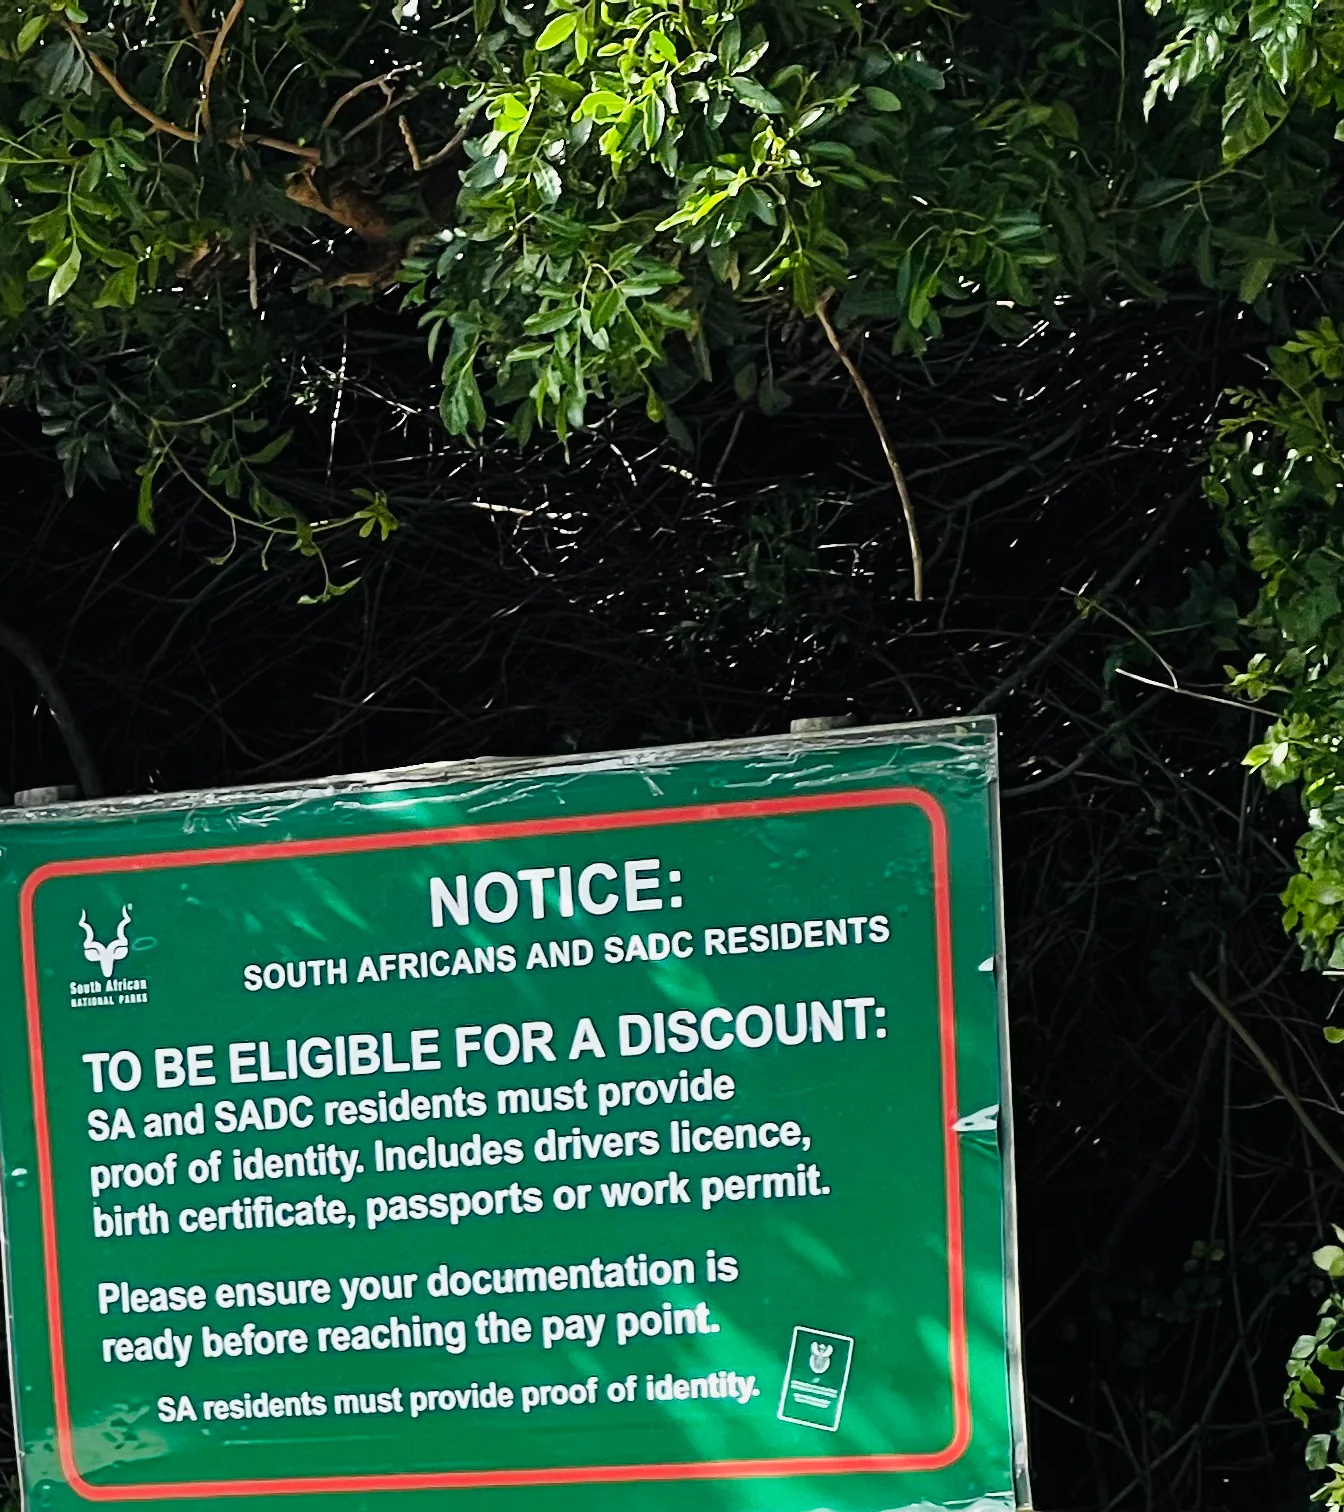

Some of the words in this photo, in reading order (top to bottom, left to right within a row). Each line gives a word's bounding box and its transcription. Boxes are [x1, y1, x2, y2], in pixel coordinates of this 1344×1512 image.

[430, 858, 682, 928] NOTICE:
[69, 981, 102, 995] South
[105, 978, 148, 992] African
[244, 958, 348, 991] SOUTH
[357, 944, 517, 983] AFRICANS
[526, 939, 594, 970] AND
[604, 930, 694, 964] SADC
[704, 915, 890, 956] RESIDENTS
[82, 1050, 142, 1093] TO
[154, 1044, 216, 1089] BE
[229, 1029, 441, 1084] ELIGIBLE
[455, 1021, 557, 1068] FOR
[568, 1017, 606, 1060] A
[618, 997, 887, 1056] DISCOUNT:
[87, 1108, 136, 1142] SA
[144, 1102, 205, 1138] and
[214, 1095, 314, 1133] SADC
[325, 1086, 487, 1126] residents
[497, 1078, 588, 1115] must
[598, 1068, 735, 1116] provide
[90, 1152, 178, 1198] proof
[188, 1149, 222, 1184] of
[233, 1143, 364, 1183] identity.
[374, 1133, 524, 1172] Includes
[534, 1127, 660, 1162] drivers
[670, 1120, 811, 1154] licence,
[93, 1202, 170, 1238] birth
[179, 1194, 356, 1233] certificate,
[366, 1182, 543, 1230] passports
[553, 1184, 592, 1211] or
[600, 1171, 691, 1208] work
[701, 1163, 831, 1210] permit.
[98, 1281, 207, 1315] Please
[215, 1278, 331, 1308] ensure
[339, 1273, 418, 1310] your
[427, 1253, 695, 1298] documentation
[706, 1249, 739, 1282] is
[102, 1328, 193, 1368] ready
[202, 1323, 308, 1358] before
[318, 1315, 466, 1354] reaching
[475, 1311, 532, 1345] the
[542, 1313, 606, 1349] pay
[617, 1301, 720, 1345] point.
[157, 1395, 198, 1423] SA
[203, 1391, 327, 1421] residents
[334, 1387, 404, 1415] must
[410, 1381, 514, 1418] provide
[521, 1376, 599, 1413] proof
[607, 1374, 638, 1403] of
[646, 1370, 760, 1404] identity.
